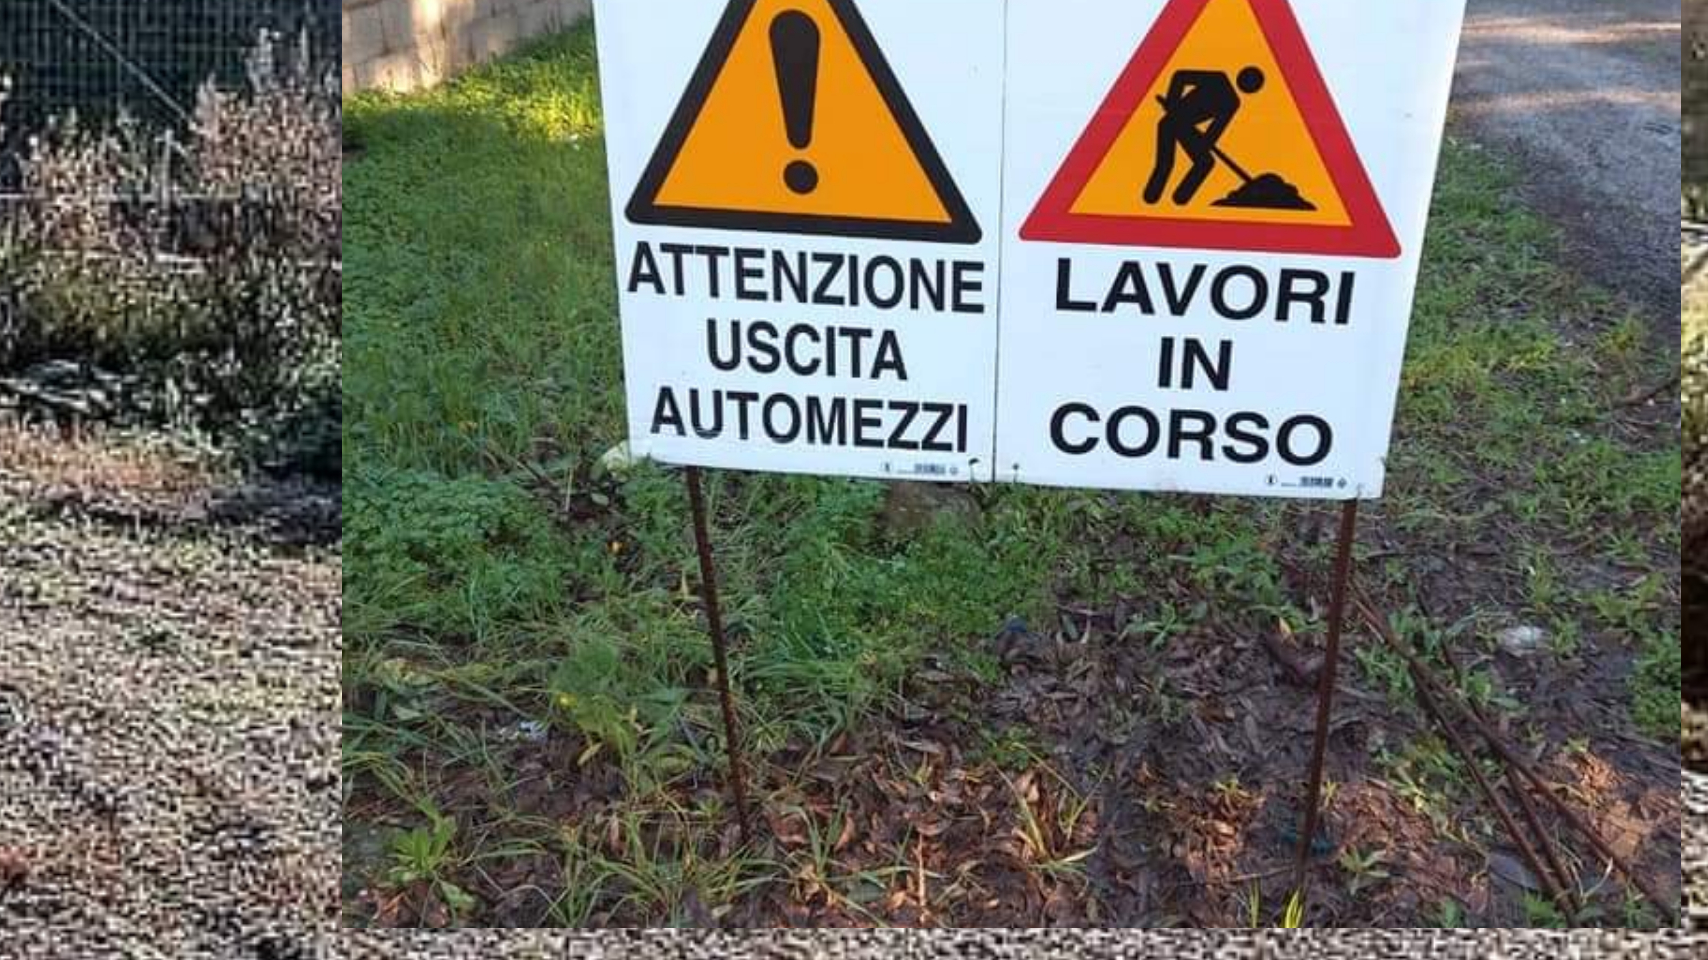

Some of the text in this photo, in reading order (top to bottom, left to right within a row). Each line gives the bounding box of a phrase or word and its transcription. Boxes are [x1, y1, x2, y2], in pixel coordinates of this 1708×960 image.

[626, 240, 985, 315] ATTENZIONE
[1055, 257, 1355, 325] LAVORI
[706, 318, 908, 381] USCITA
[1157, 336, 1233, 391] IN
[650, 386, 968, 453] AUTOMEZZI
[1050, 402, 1334, 468] CORSO
